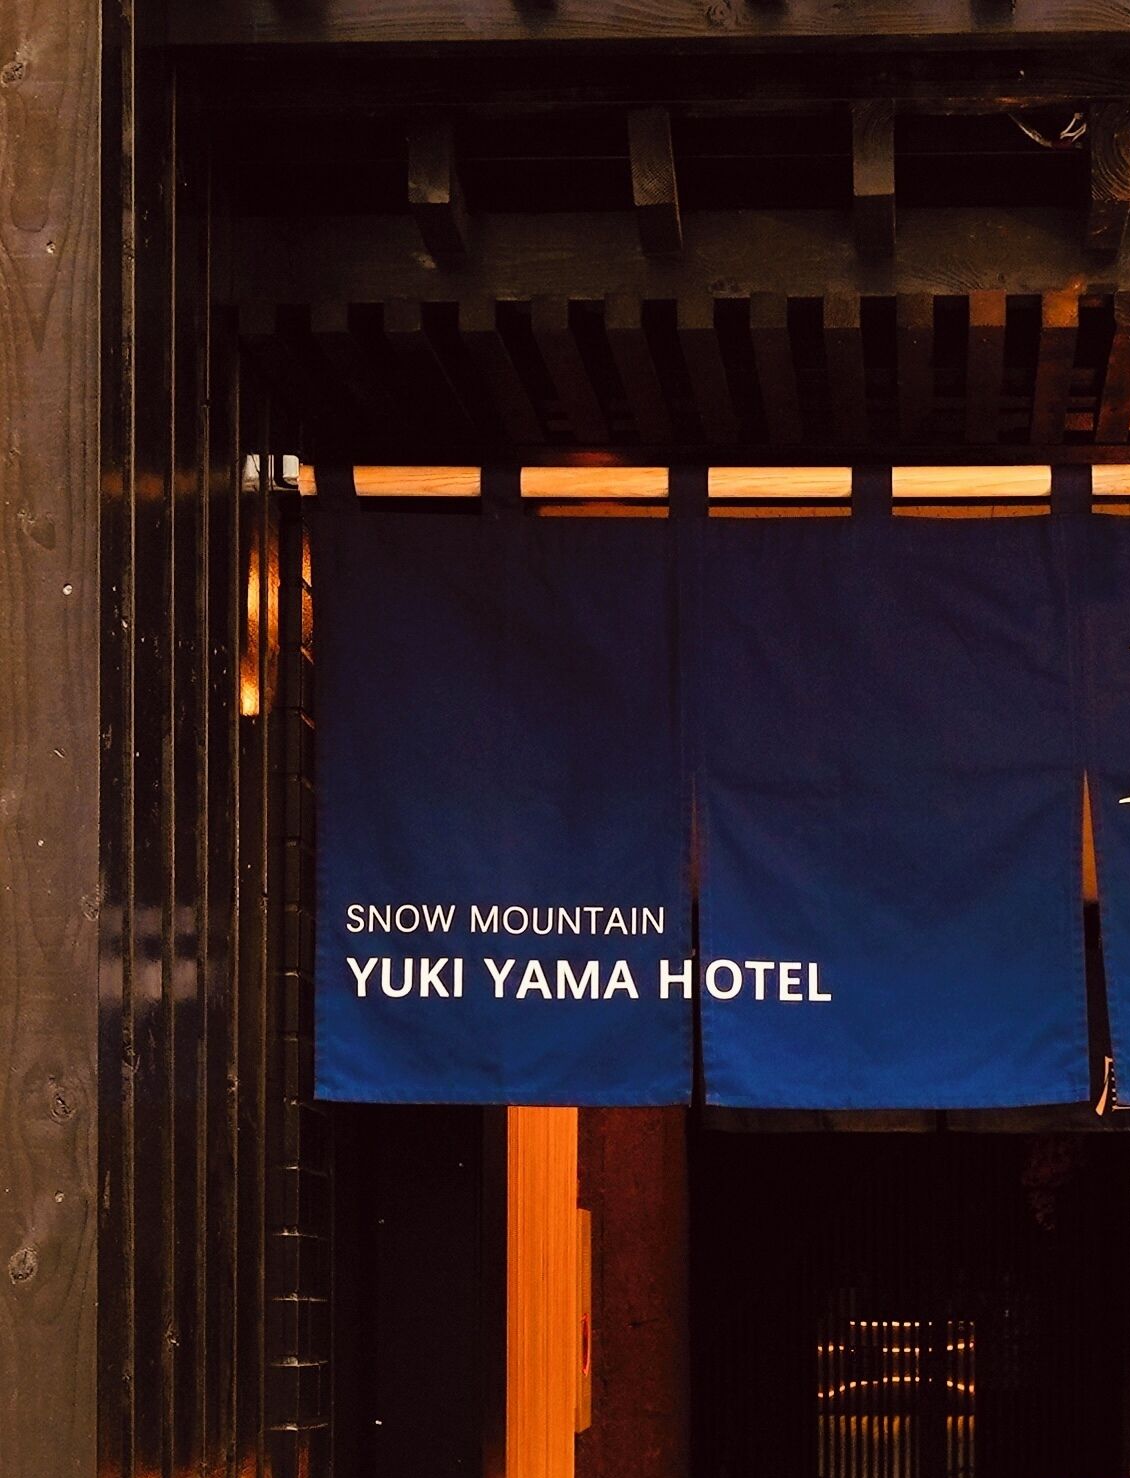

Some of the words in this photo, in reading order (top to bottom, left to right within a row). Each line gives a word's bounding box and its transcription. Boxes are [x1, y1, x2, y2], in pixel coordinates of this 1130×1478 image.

[346, 904, 456, 933] SNOW
[470, 905, 664, 935] MOUNTAIN
[346, 957, 463, 998] YUKI
[483, 958, 639, 1000] YAMA
[659, 959, 832, 1002] HOTEL
